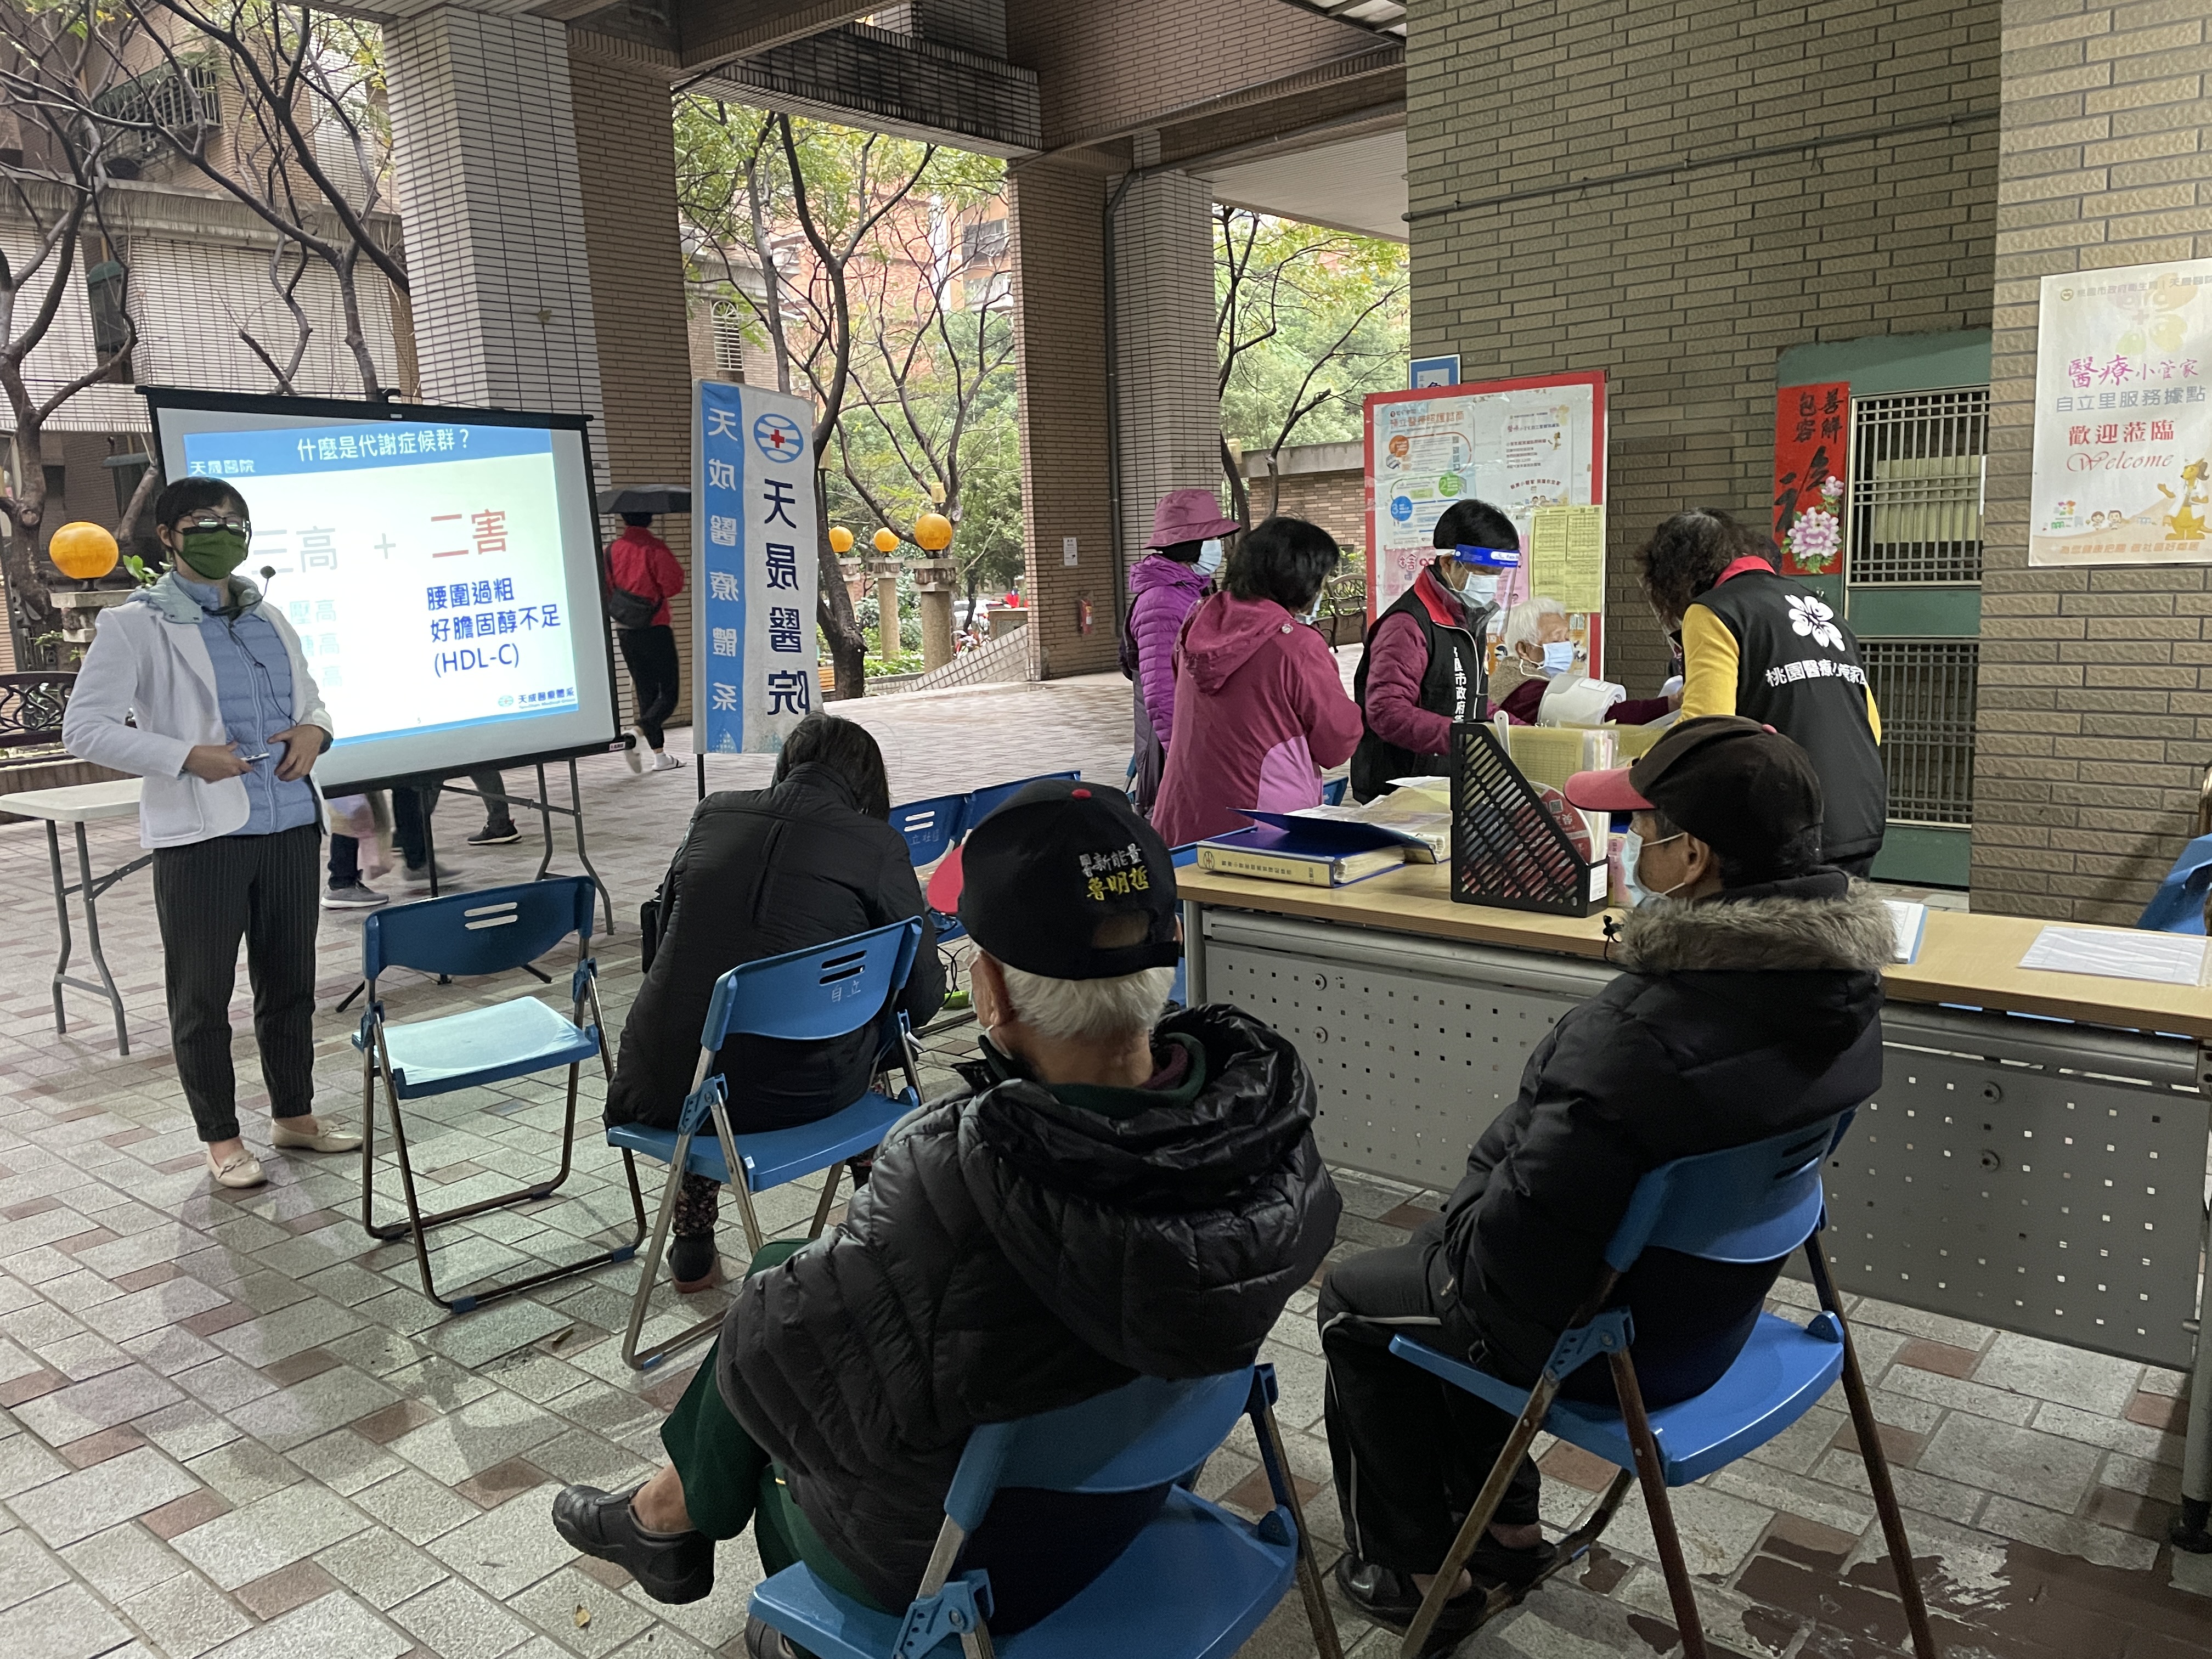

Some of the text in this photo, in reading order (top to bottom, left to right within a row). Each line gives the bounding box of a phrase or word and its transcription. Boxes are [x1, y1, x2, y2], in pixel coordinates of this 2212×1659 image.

[2068, 354, 2199, 388] 醫療小管家
[1820, 388, 1844, 444] 善解
[2056, 386, 2205, 412] 自立里服務據點
[1793, 391, 1818, 443] 包容
[2069, 419, 2174, 447] 歡迎蒞臨
[297, 428, 469, 461] 什麼是代謝症候群？
[2067, 451, 2174, 472] Welcome
[251, 526, 338, 574] 三高
[431, 509, 509, 559] 二害
[427, 577, 515, 611] 腰圍過粗
[279, 600, 336, 624] 壓高
[430, 603, 561, 643] 好膽固醇不足
[435, 643, 519, 678] (HDL-C)
[832, 980, 861, 1002] 自立
